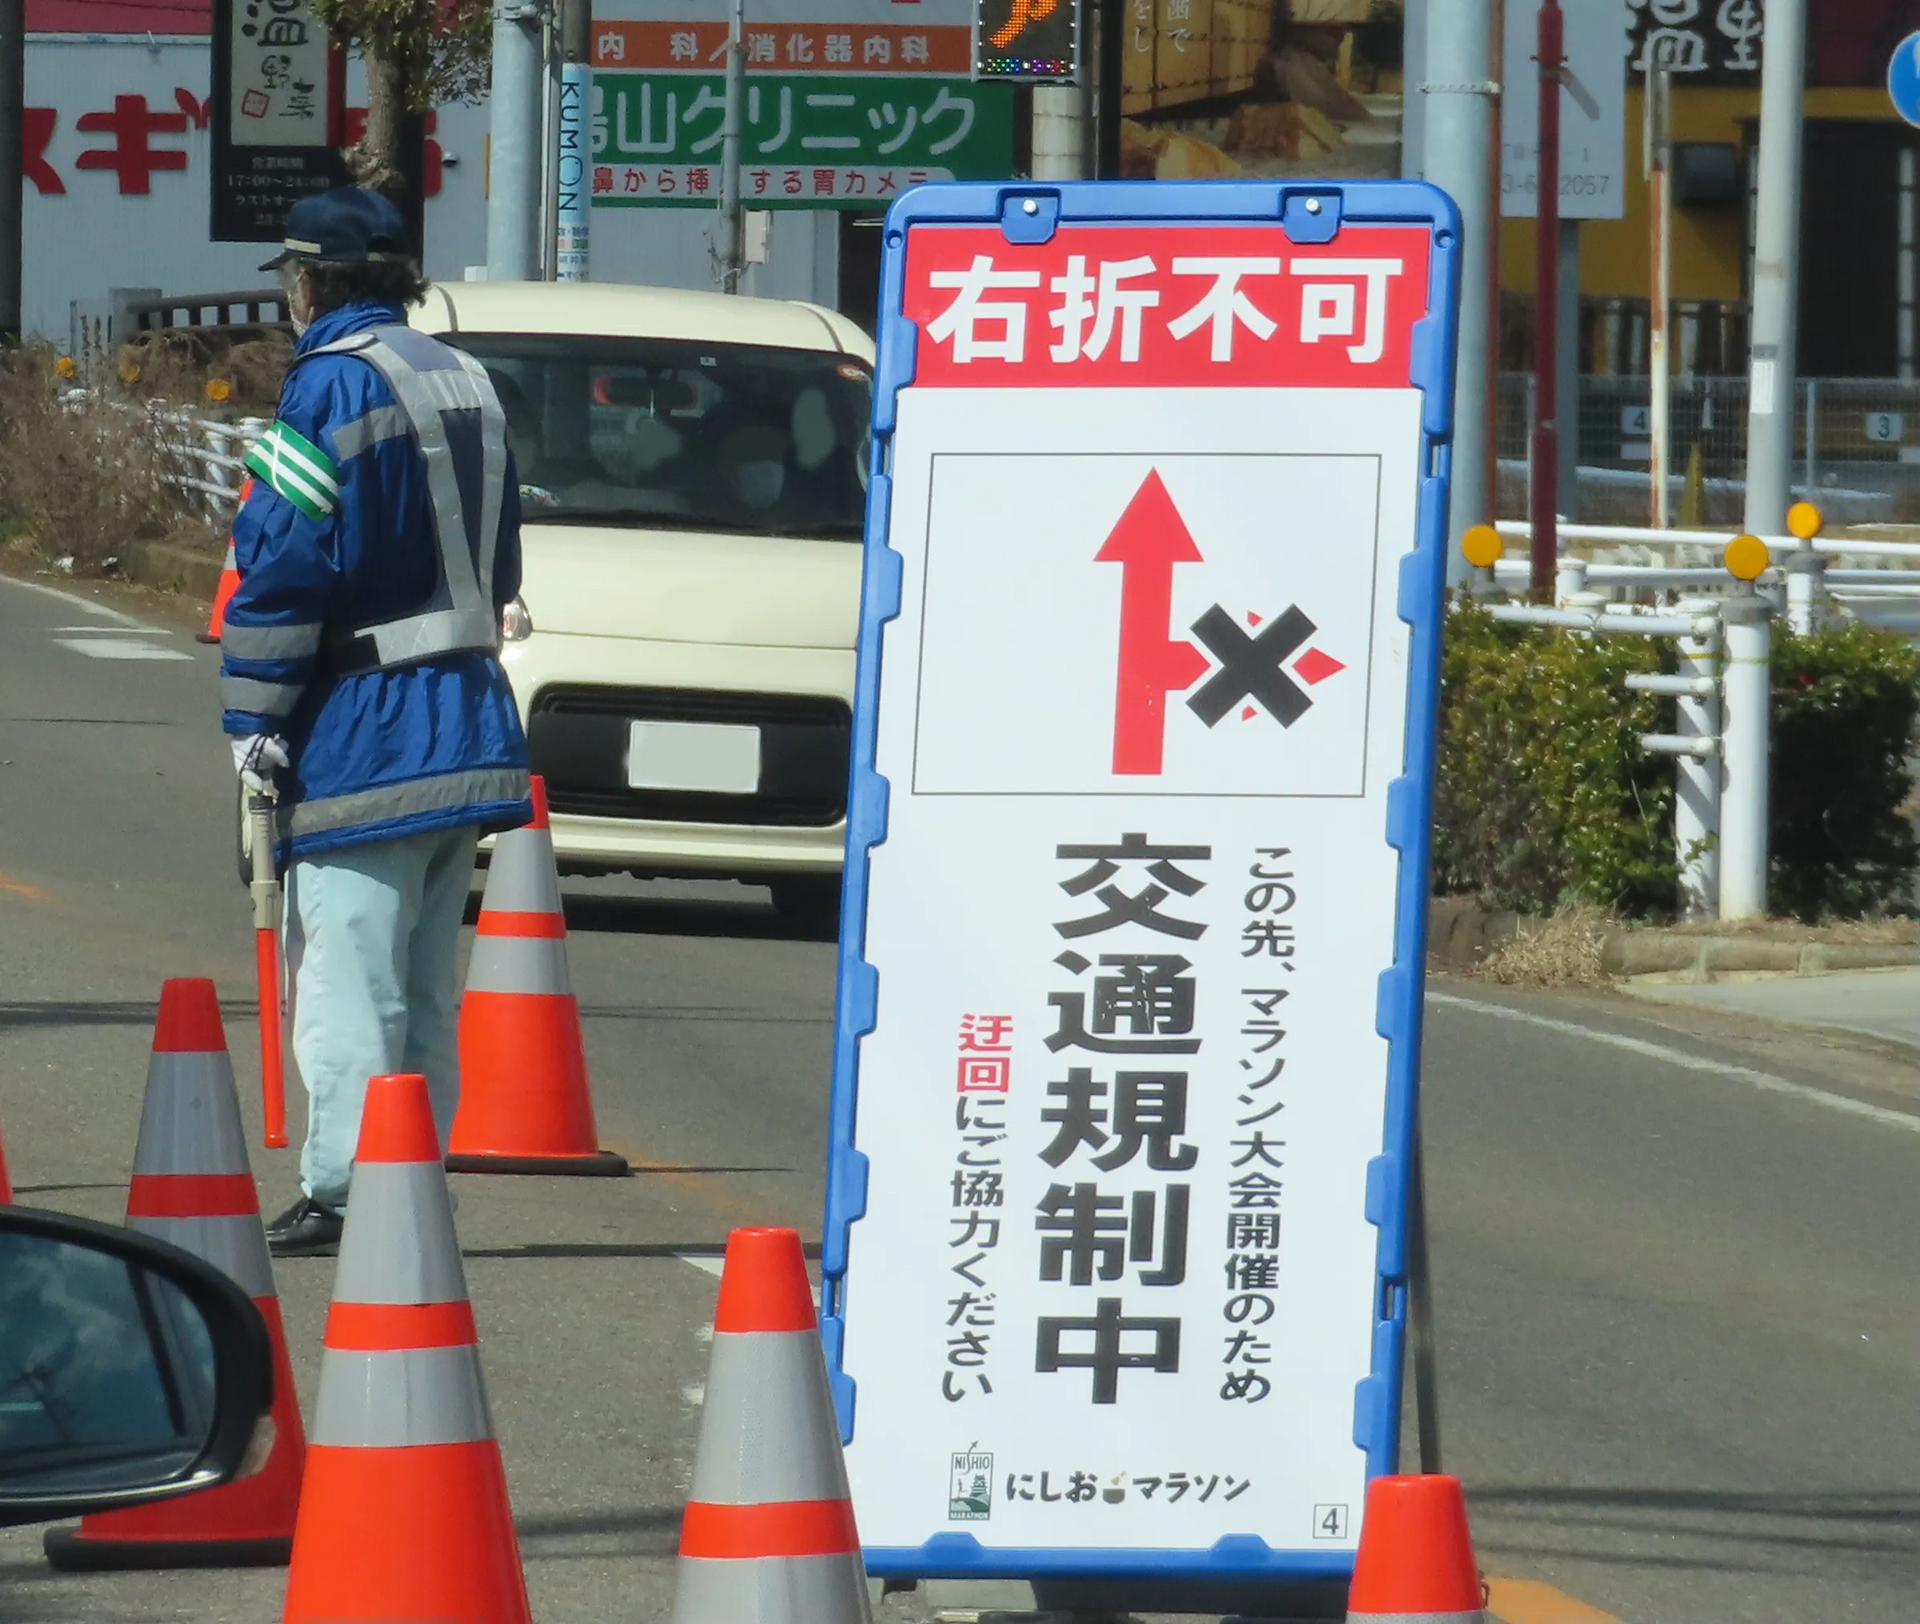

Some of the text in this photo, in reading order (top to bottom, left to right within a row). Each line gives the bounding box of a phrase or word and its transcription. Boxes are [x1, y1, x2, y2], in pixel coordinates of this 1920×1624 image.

[558, 82, 583, 212] KUMON
[925, 254, 1403, 364] 右折不可
[1633, 411, 1646, 430] 4
[1878, 415, 1890, 438] 3
[1034, 832, 1213, 1405] 交通規制中
[1219, 847, 1297, 1404] この先、マラソン大会開催のため
[941, 1013, 1014, 1403] 迂回にご協力ください
[954, 1455, 991, 1472] NISHIO
[1321, 1508, 1340, 1536] 4
